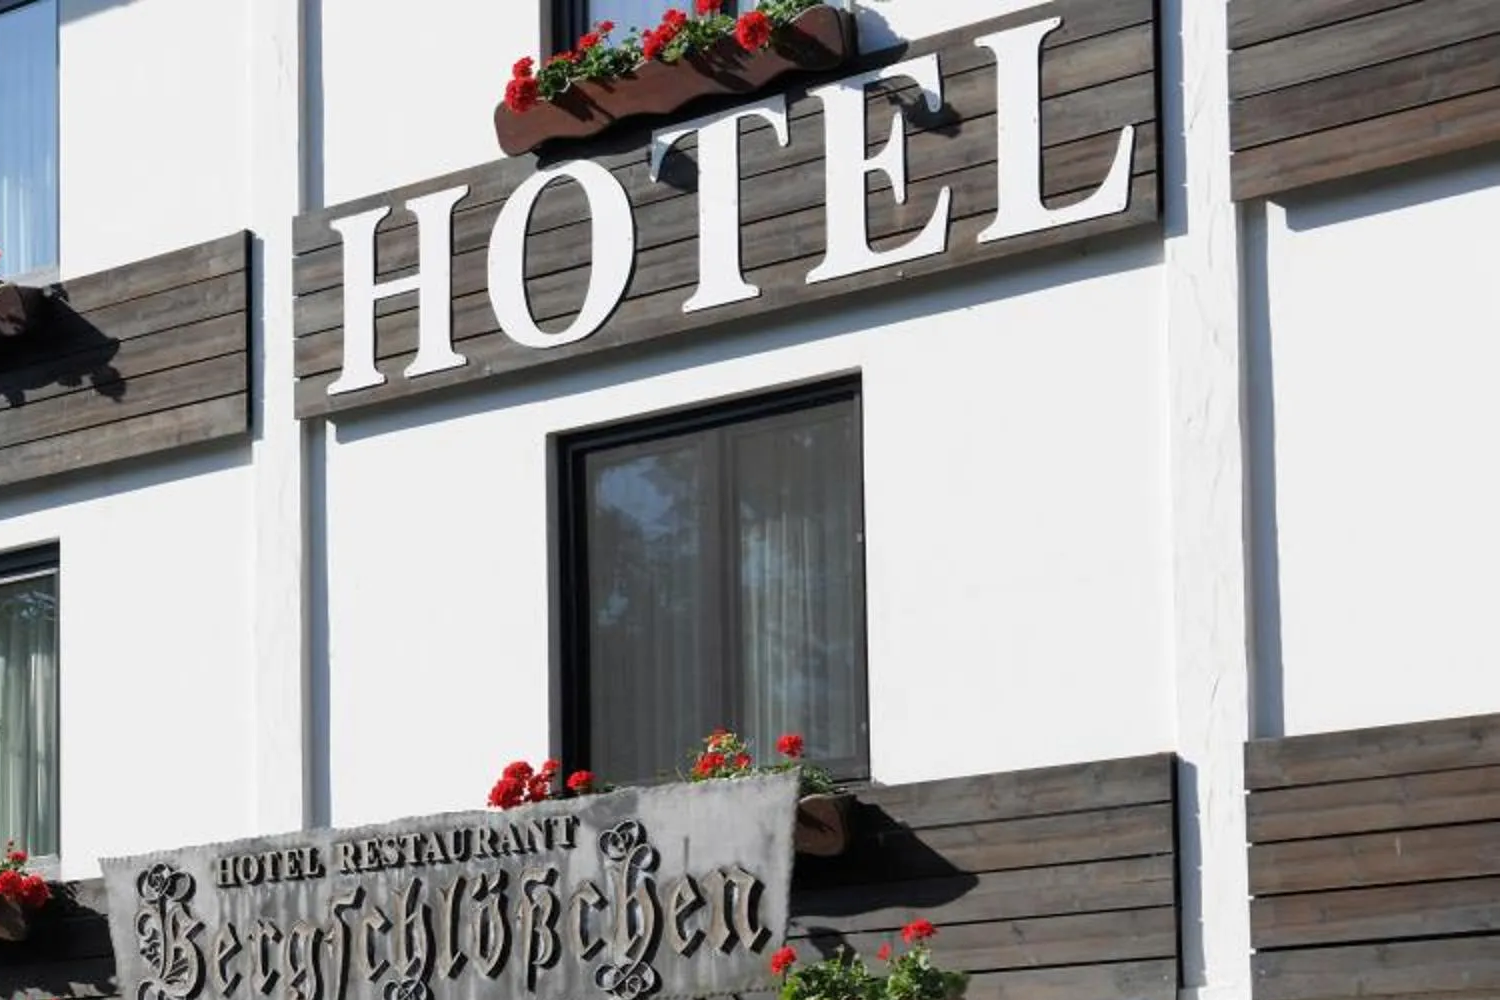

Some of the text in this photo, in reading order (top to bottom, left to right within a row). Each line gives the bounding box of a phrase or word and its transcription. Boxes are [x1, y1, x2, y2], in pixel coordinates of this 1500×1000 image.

[327, 17, 1134, 395] HOTEL
[216, 814, 580, 888] HOTEL RESTAURANT
